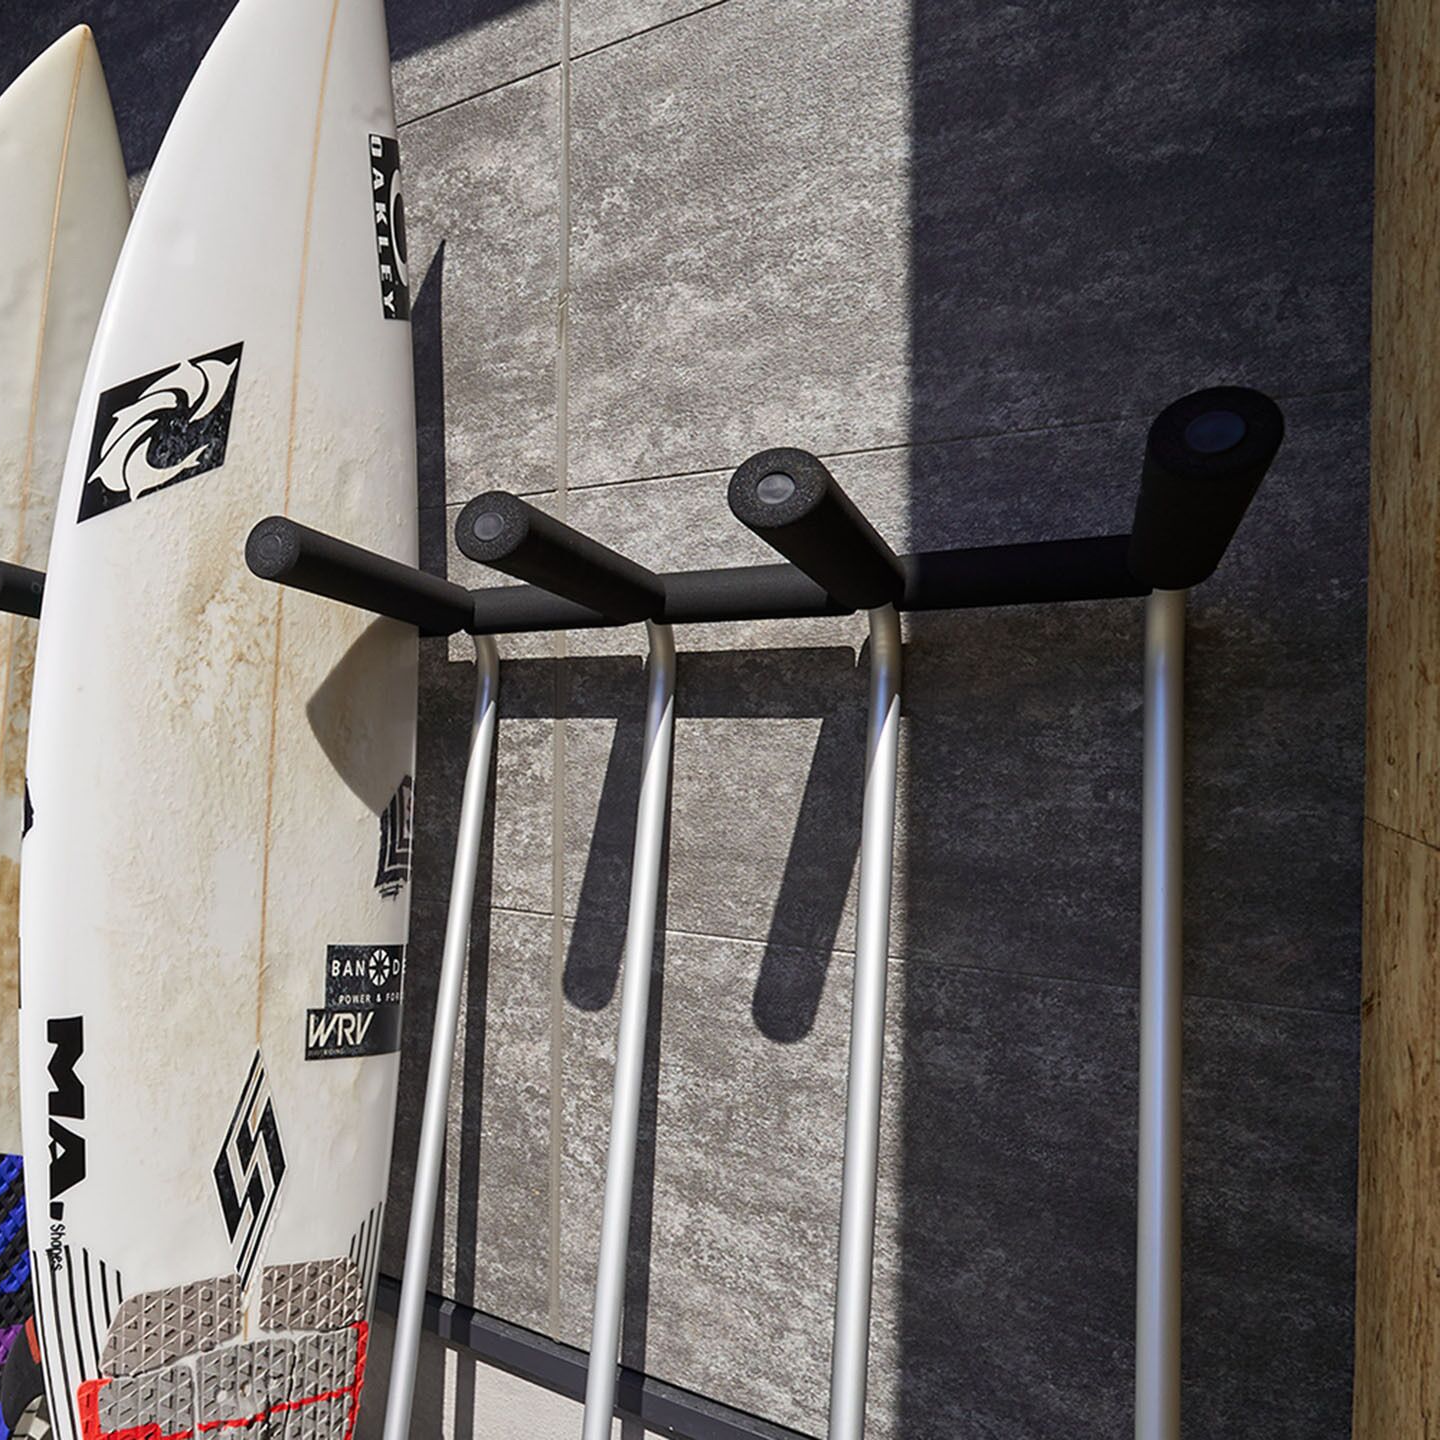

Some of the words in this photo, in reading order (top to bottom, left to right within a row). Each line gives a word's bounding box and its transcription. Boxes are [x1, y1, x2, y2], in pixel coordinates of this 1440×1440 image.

[370, 134, 396, 314] OAKLEY
[338, 994, 372, 1005] POWER
[375, 992, 382, 1003] &
[308, 1011, 375, 1049] WRV
